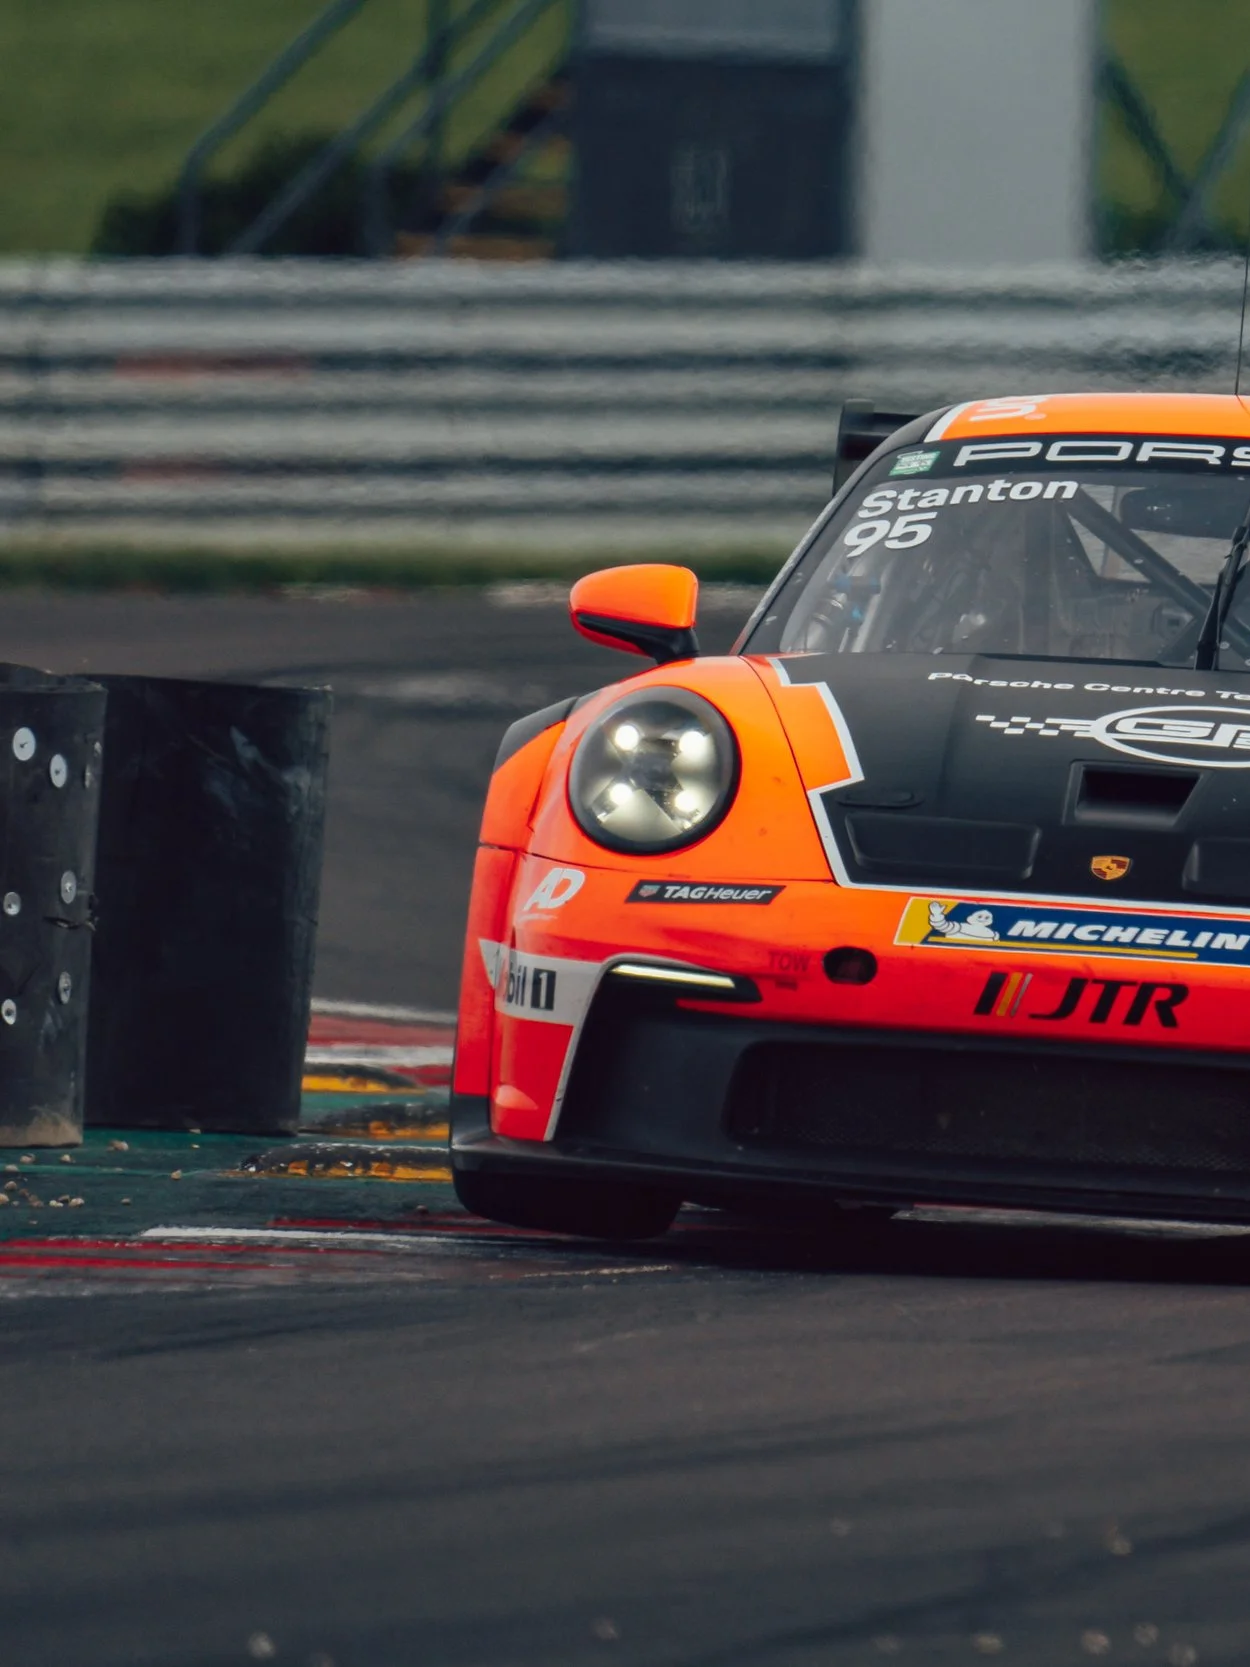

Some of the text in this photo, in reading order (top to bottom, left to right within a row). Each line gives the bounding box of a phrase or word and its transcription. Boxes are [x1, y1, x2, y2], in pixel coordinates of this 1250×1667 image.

[857, 479, 1079, 519] Stanton
[843, 511, 938, 558] 95
[927, 672, 1075, 690] Porsche
[1083, 682, 1206, 698] Centre
[768, 950, 813, 972] TOW
[1029, 977, 1191, 1029] JTR
